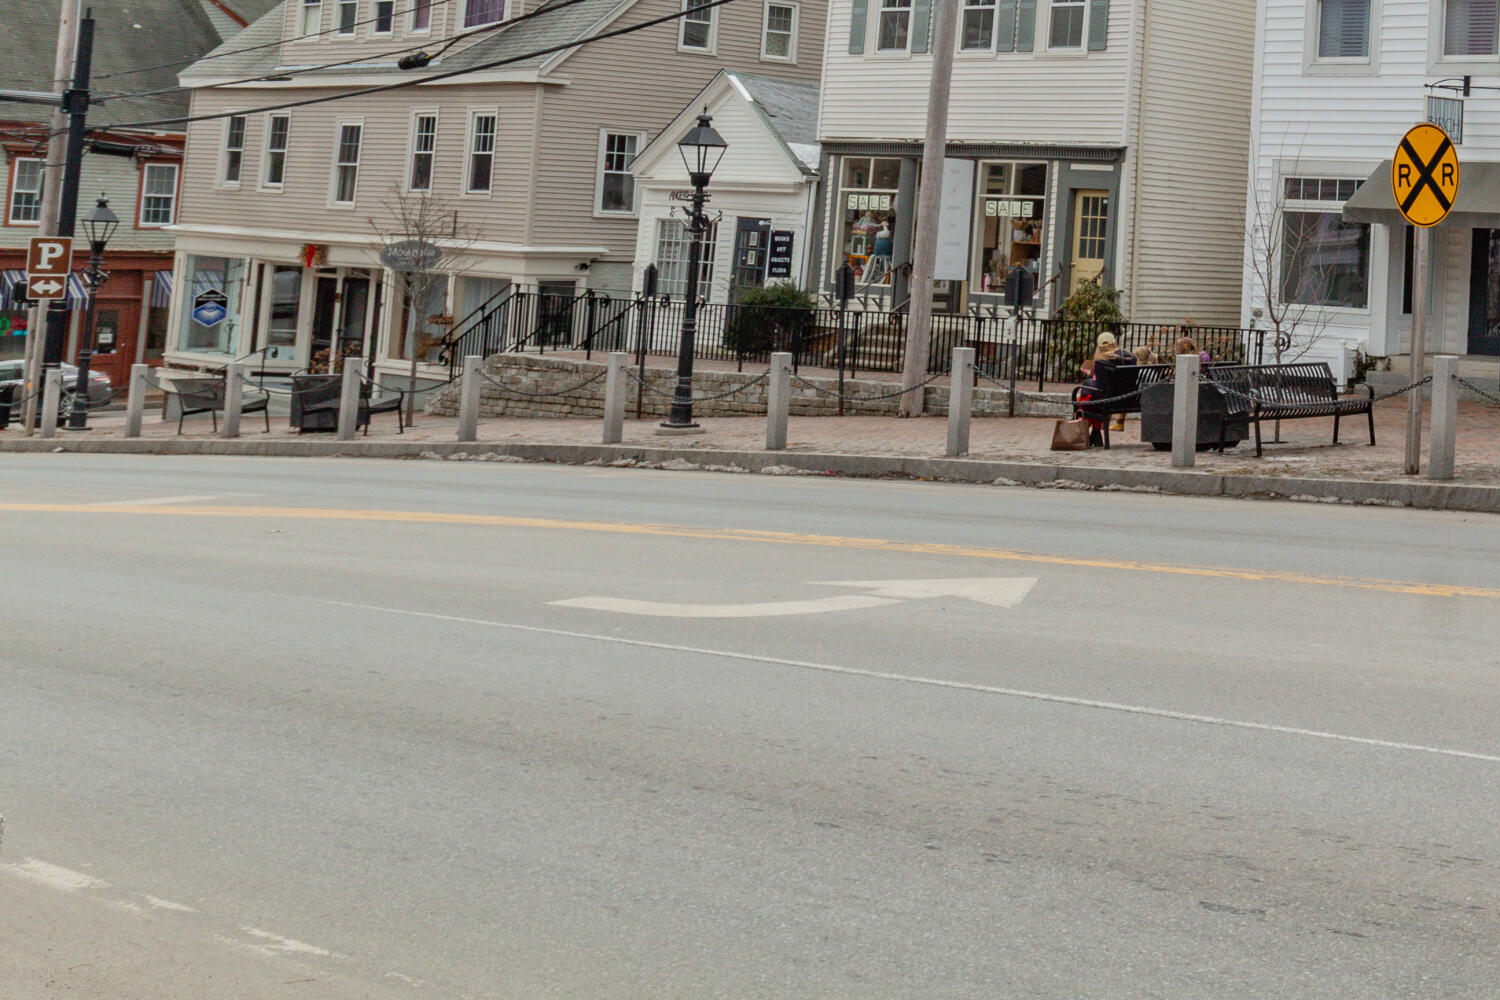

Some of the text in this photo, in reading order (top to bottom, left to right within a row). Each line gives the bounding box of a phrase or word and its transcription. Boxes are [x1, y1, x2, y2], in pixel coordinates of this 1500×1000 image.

[1398, 163, 1454, 187] R R
[849, 195, 890, 210] SALE
[986, 201, 1033, 216] SALE
[36, 242, 64, 269] P
